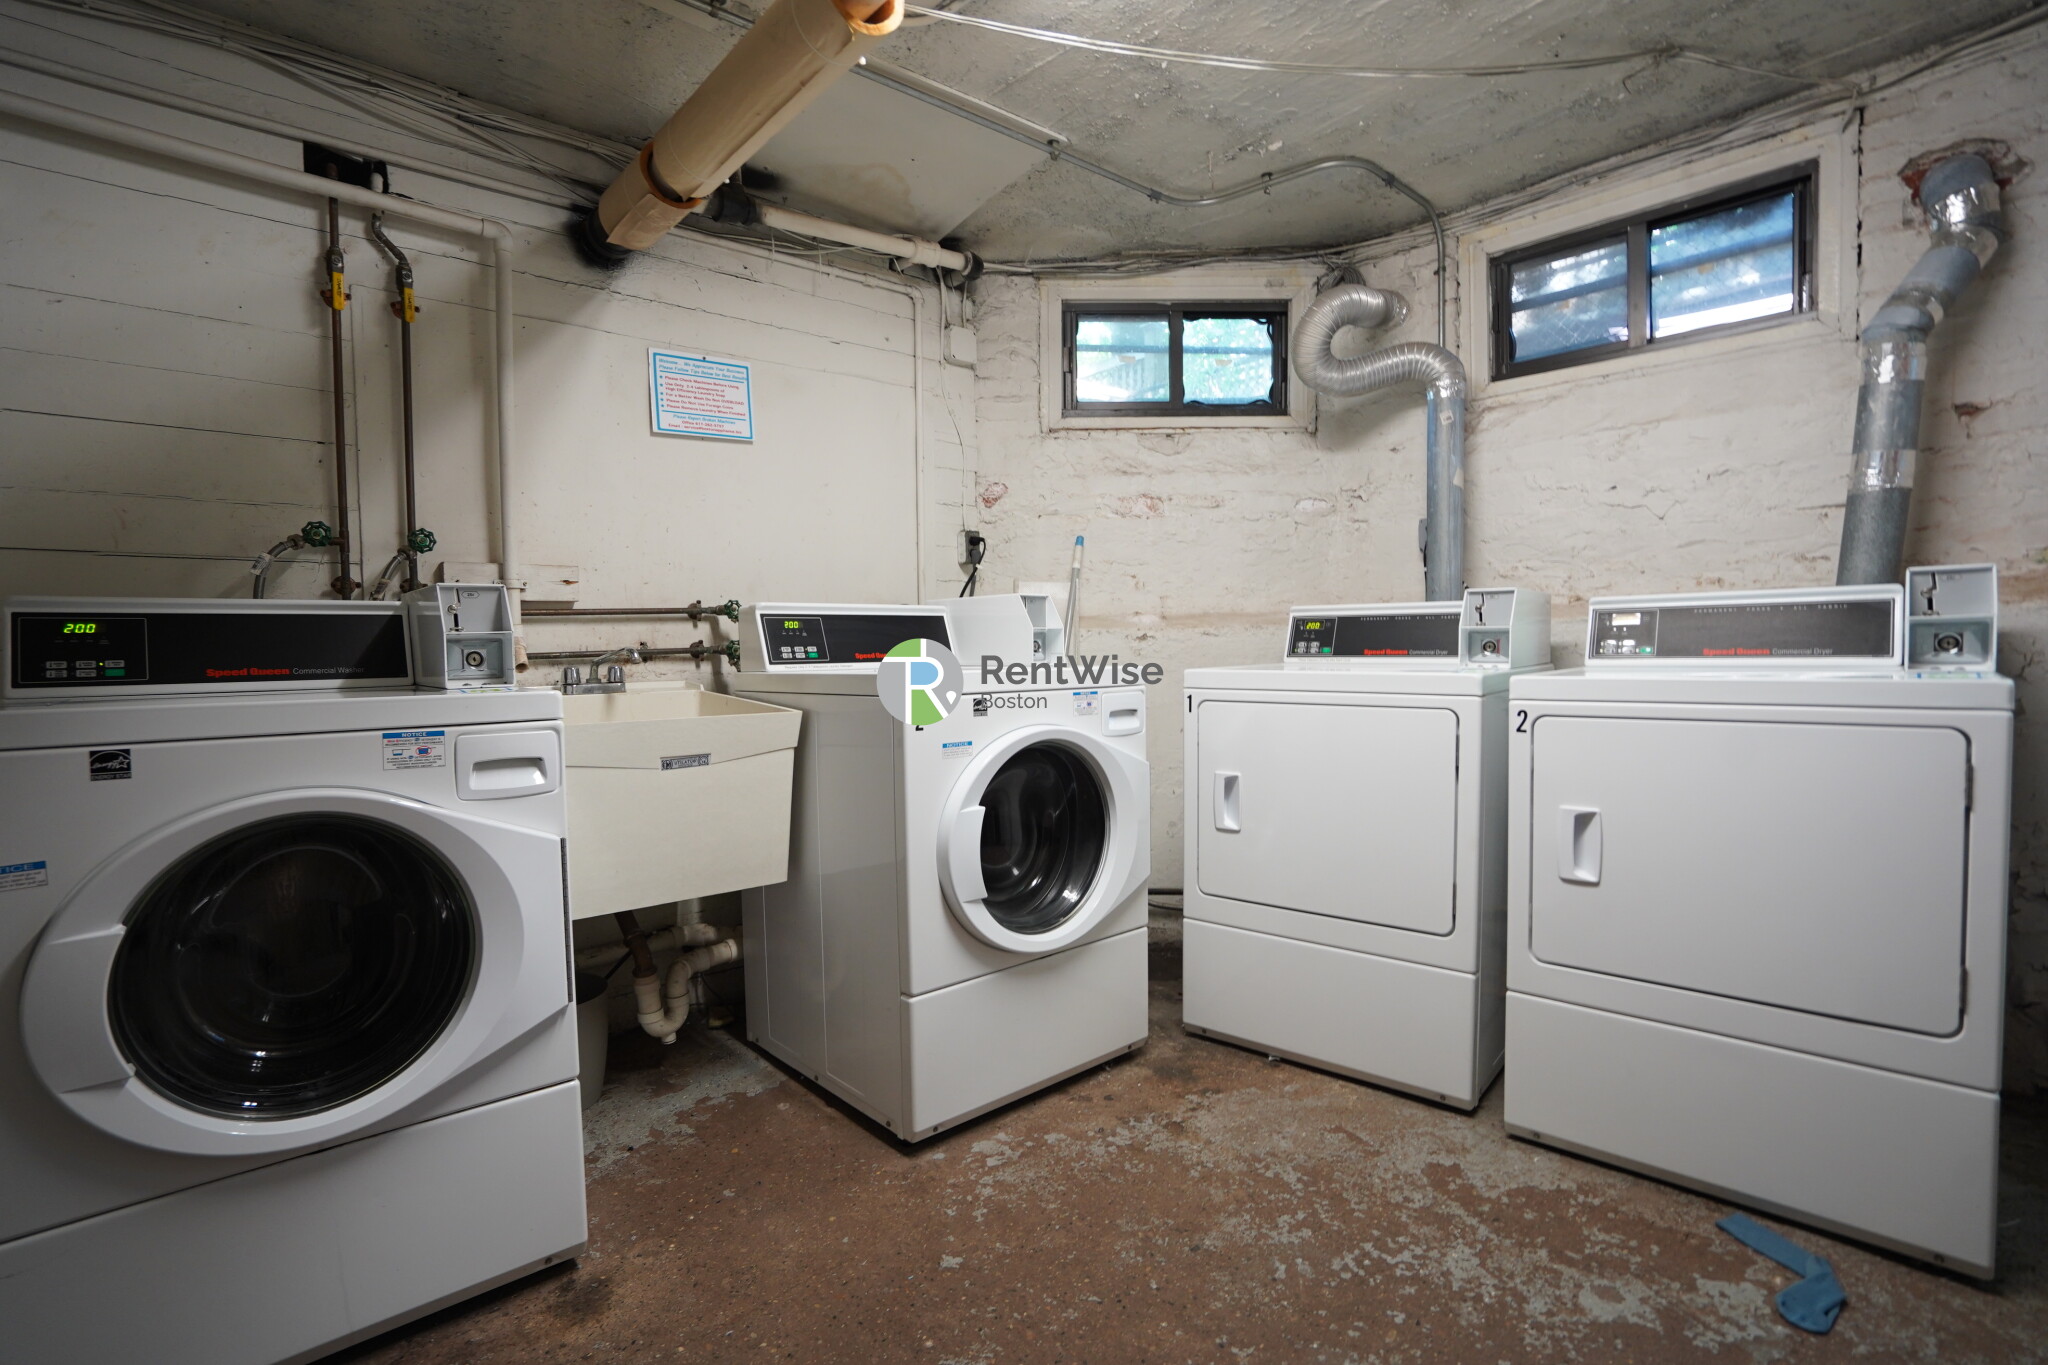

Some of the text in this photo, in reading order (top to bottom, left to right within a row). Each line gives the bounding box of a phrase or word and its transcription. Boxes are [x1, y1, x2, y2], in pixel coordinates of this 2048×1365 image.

[63, 623, 96, 634] 200
[1703, 648, 1735, 656] Speed
[1814, 648, 1833, 656] Dryer
[206, 668, 248, 678] Speed
[1186, 694, 1193, 712] 1
[1516, 710, 1528, 732] 2
